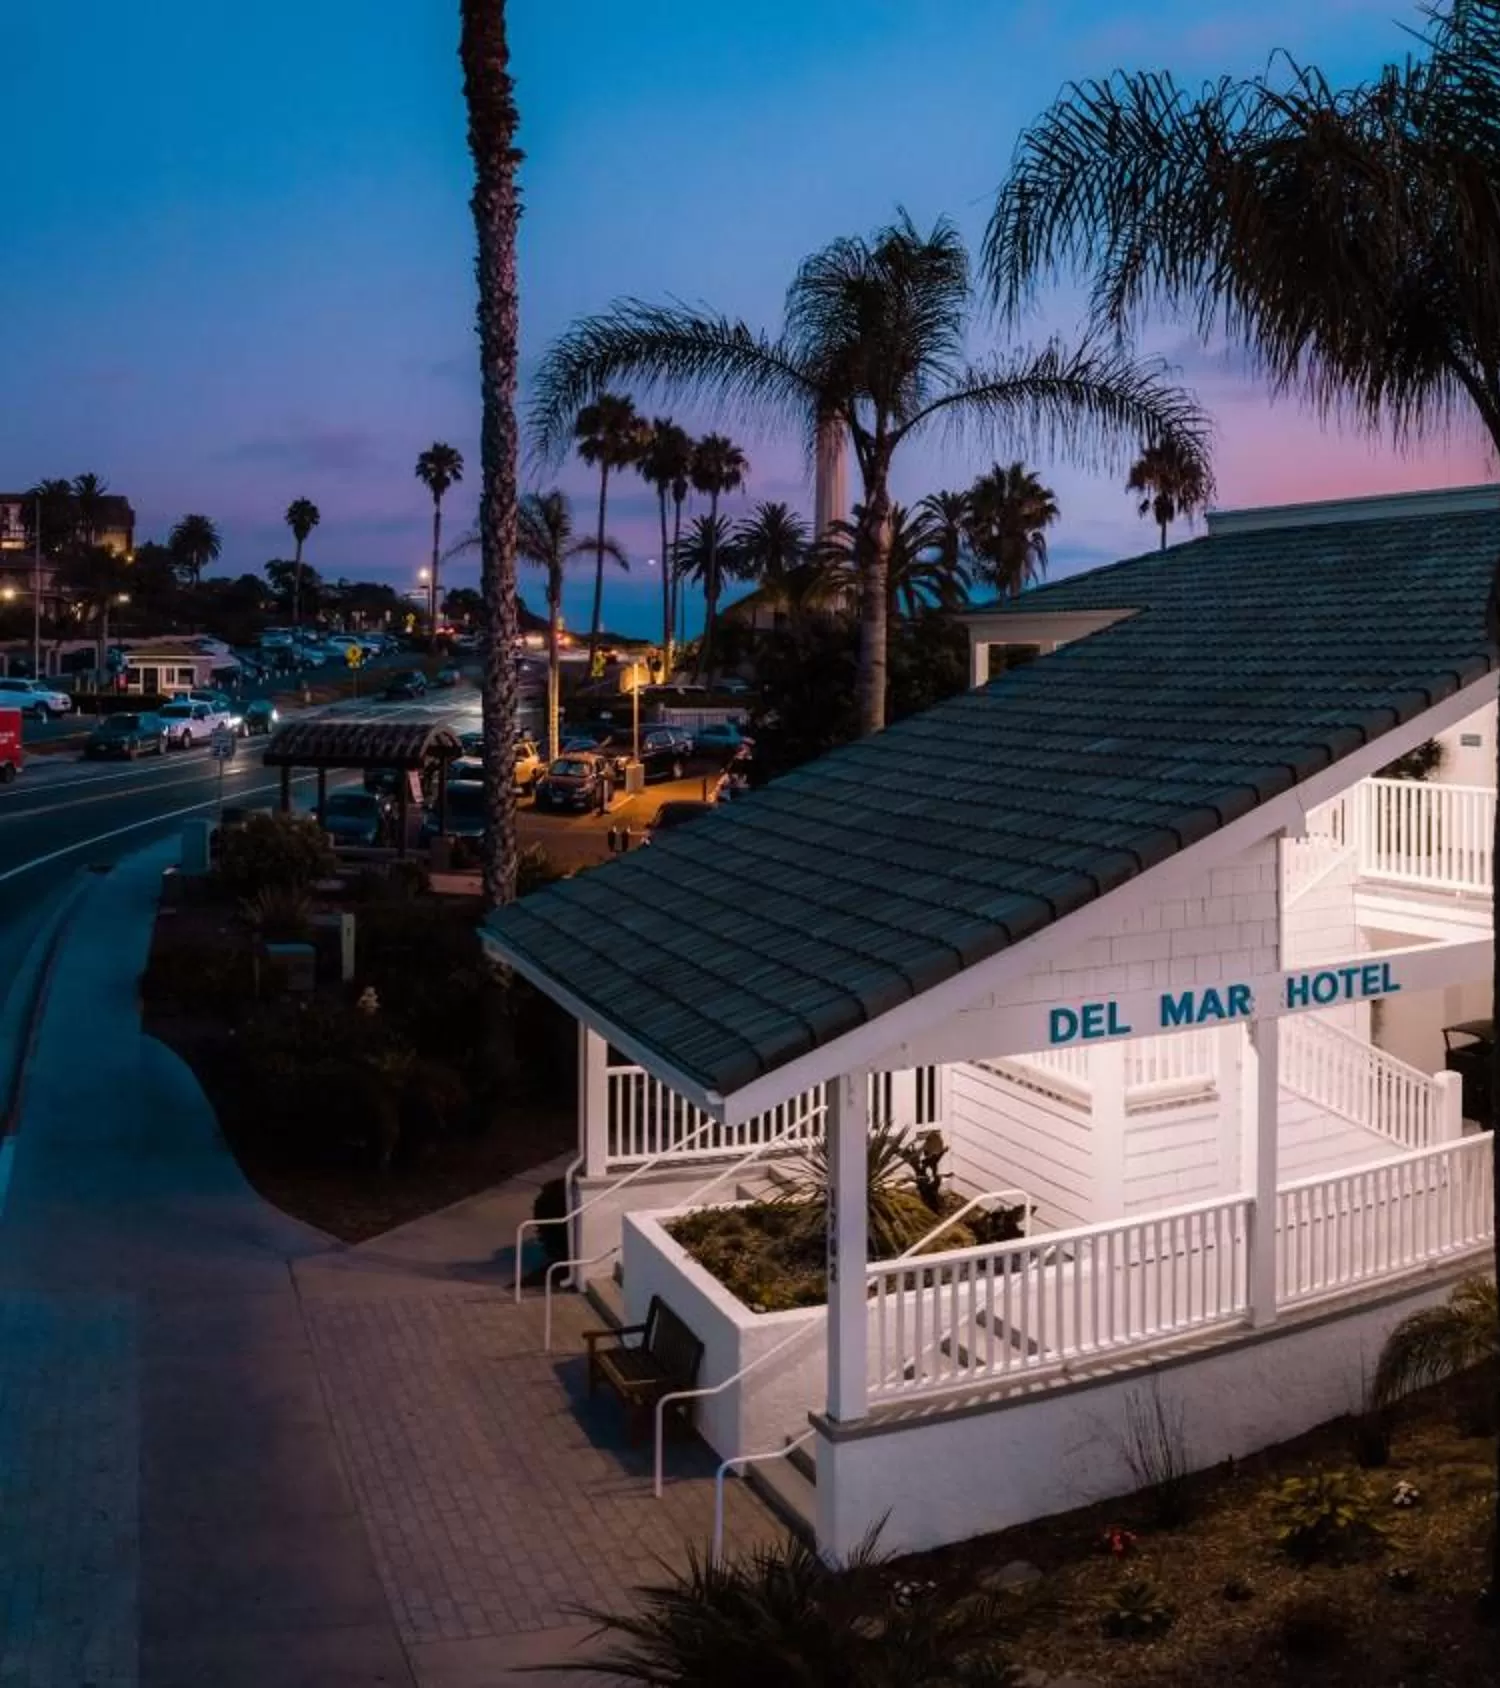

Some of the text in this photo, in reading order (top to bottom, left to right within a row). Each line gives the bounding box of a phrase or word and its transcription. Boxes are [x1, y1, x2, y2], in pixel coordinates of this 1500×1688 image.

[1049, 963, 1403, 1044] DEL MAR HOTEL
